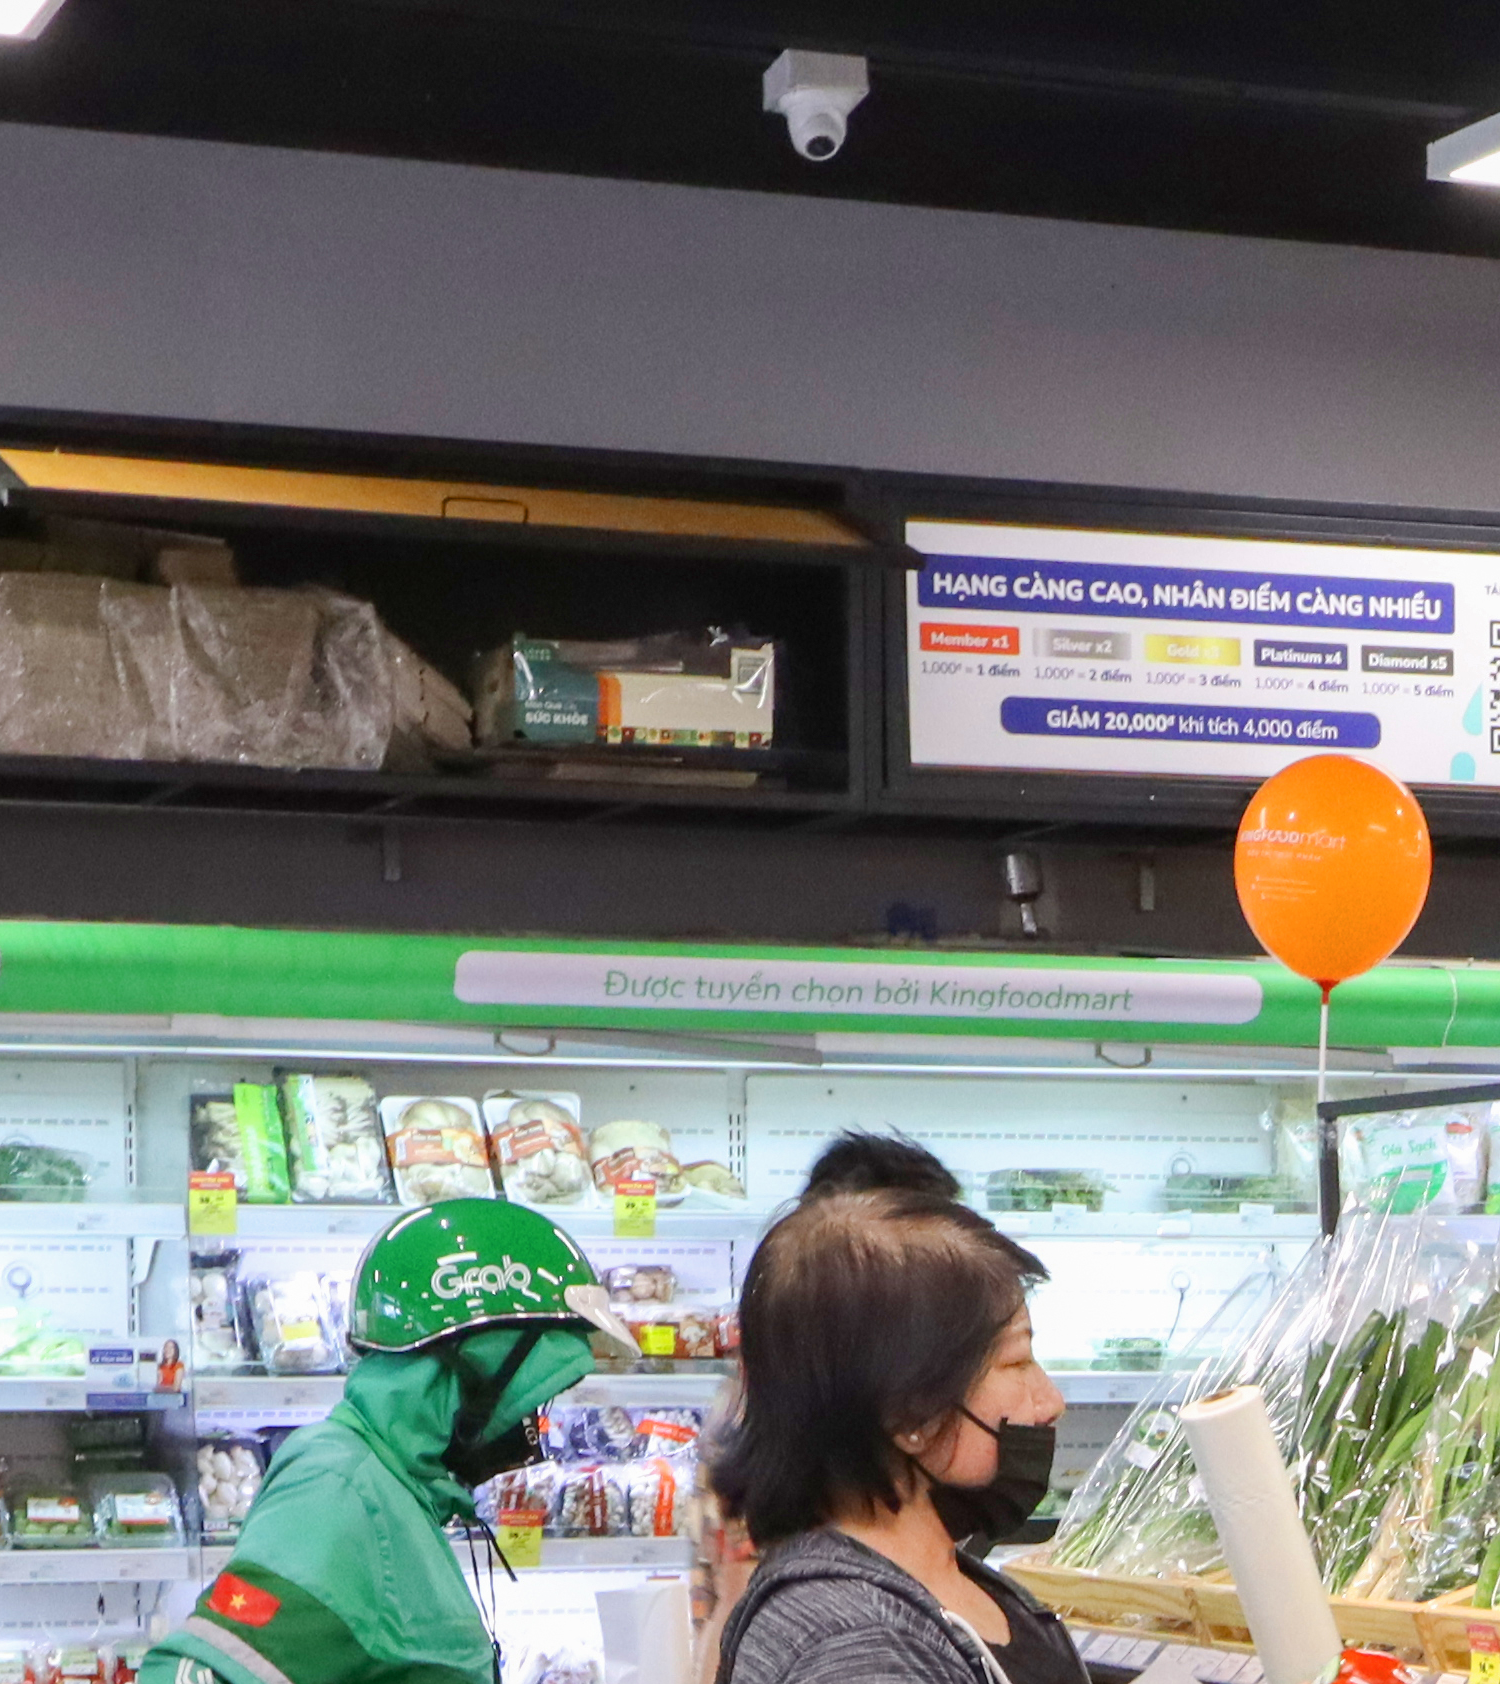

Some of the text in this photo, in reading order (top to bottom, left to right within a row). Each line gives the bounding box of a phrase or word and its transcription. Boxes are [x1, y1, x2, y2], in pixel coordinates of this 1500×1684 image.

[933, 572, 1007, 602] HẠNG
[1013, 571, 1084, 601] CÀNG
[1089, 580, 1148, 608] CAO,
[1153, 580, 1226, 610] NHÂN
[1229, 581, 1290, 613] ĐIỂM
[1296, 586, 1363, 617] CÀNG
[931, 631, 1010, 649] Member x1
[1052, 636, 1113, 654] Silver x2
[1260, 648, 1342, 666] Platinum x4
[1368, 653, 1448, 671] Diamond x5
[1046, 704, 1100, 730] GIẢM
[1179, 714, 1204, 734] khi
[1207, 715, 1239, 736] tích
[1243, 718, 1292, 739] 4,000
[1296, 718, 1338, 740] điểm
[604, 970, 1134, 1013] Được tuyển chọn bởi Kingfoodmart
[431, 1255, 531, 1302] Grab
